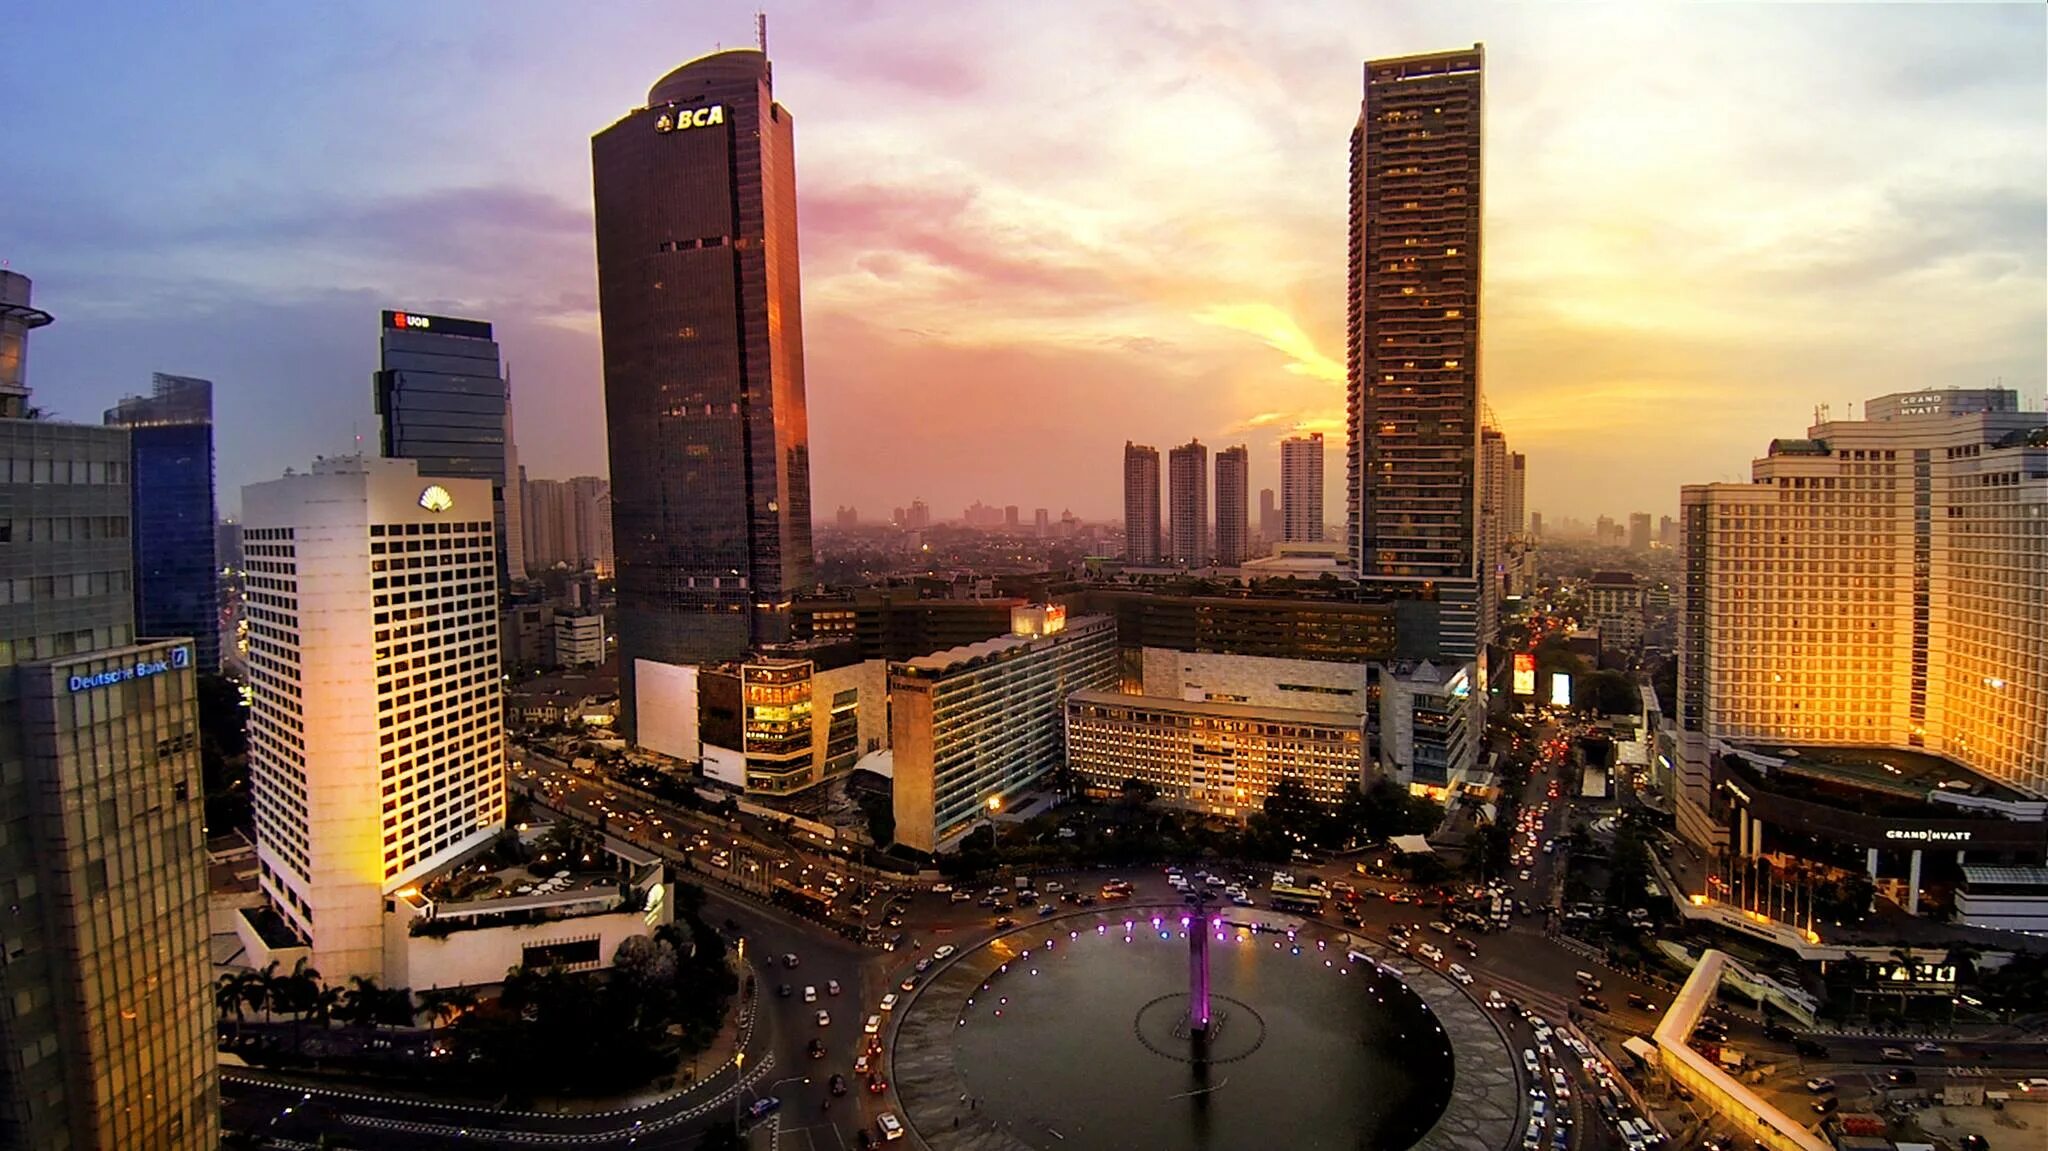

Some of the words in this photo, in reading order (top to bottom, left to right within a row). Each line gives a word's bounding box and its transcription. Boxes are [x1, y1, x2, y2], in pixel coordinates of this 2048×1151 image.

[677, 105, 724, 130] BCA
[406, 315, 430, 328] UOB
[1900, 394, 1942, 405] GRAND
[1900, 405, 1941, 415] HYATT
[70, 668, 134, 691] Deutsche
[135, 660, 168, 677] Bank
[1886, 831, 1927, 840] GRAND
[1932, 831, 1971, 840] HYATT
